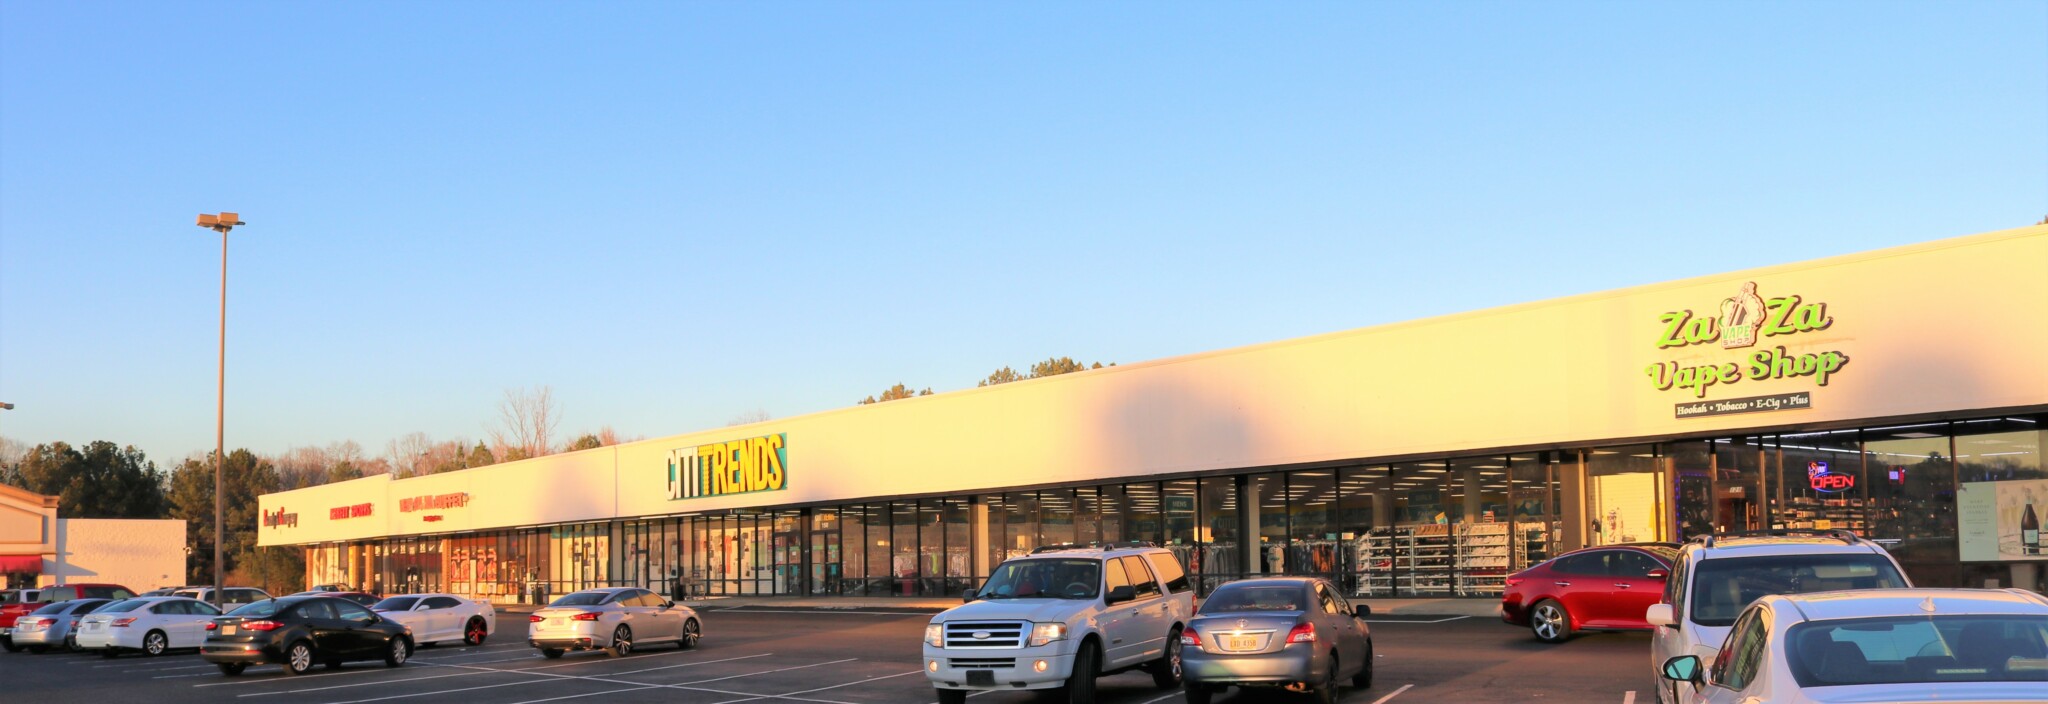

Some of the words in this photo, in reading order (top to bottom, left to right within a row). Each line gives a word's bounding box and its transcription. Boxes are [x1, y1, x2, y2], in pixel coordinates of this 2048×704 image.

[1656, 309, 1720, 349] Za
[1764, 295, 1833, 336] Za
[1722, 325, 1750, 340] VAPE
[1723, 338, 1751, 347] SHOP
[1645, 361, 1741, 398] Vape
[1747, 346, 1849, 385] Shop
[1677, 403, 1707, 415] Hookah
[1716, 401, 1747, 412] Tobacco
[1756, 399, 1780, 410] E-Cig
[1790, 395, 1808, 405] Plus
[1811, 475, 1855, 489] OPEN
